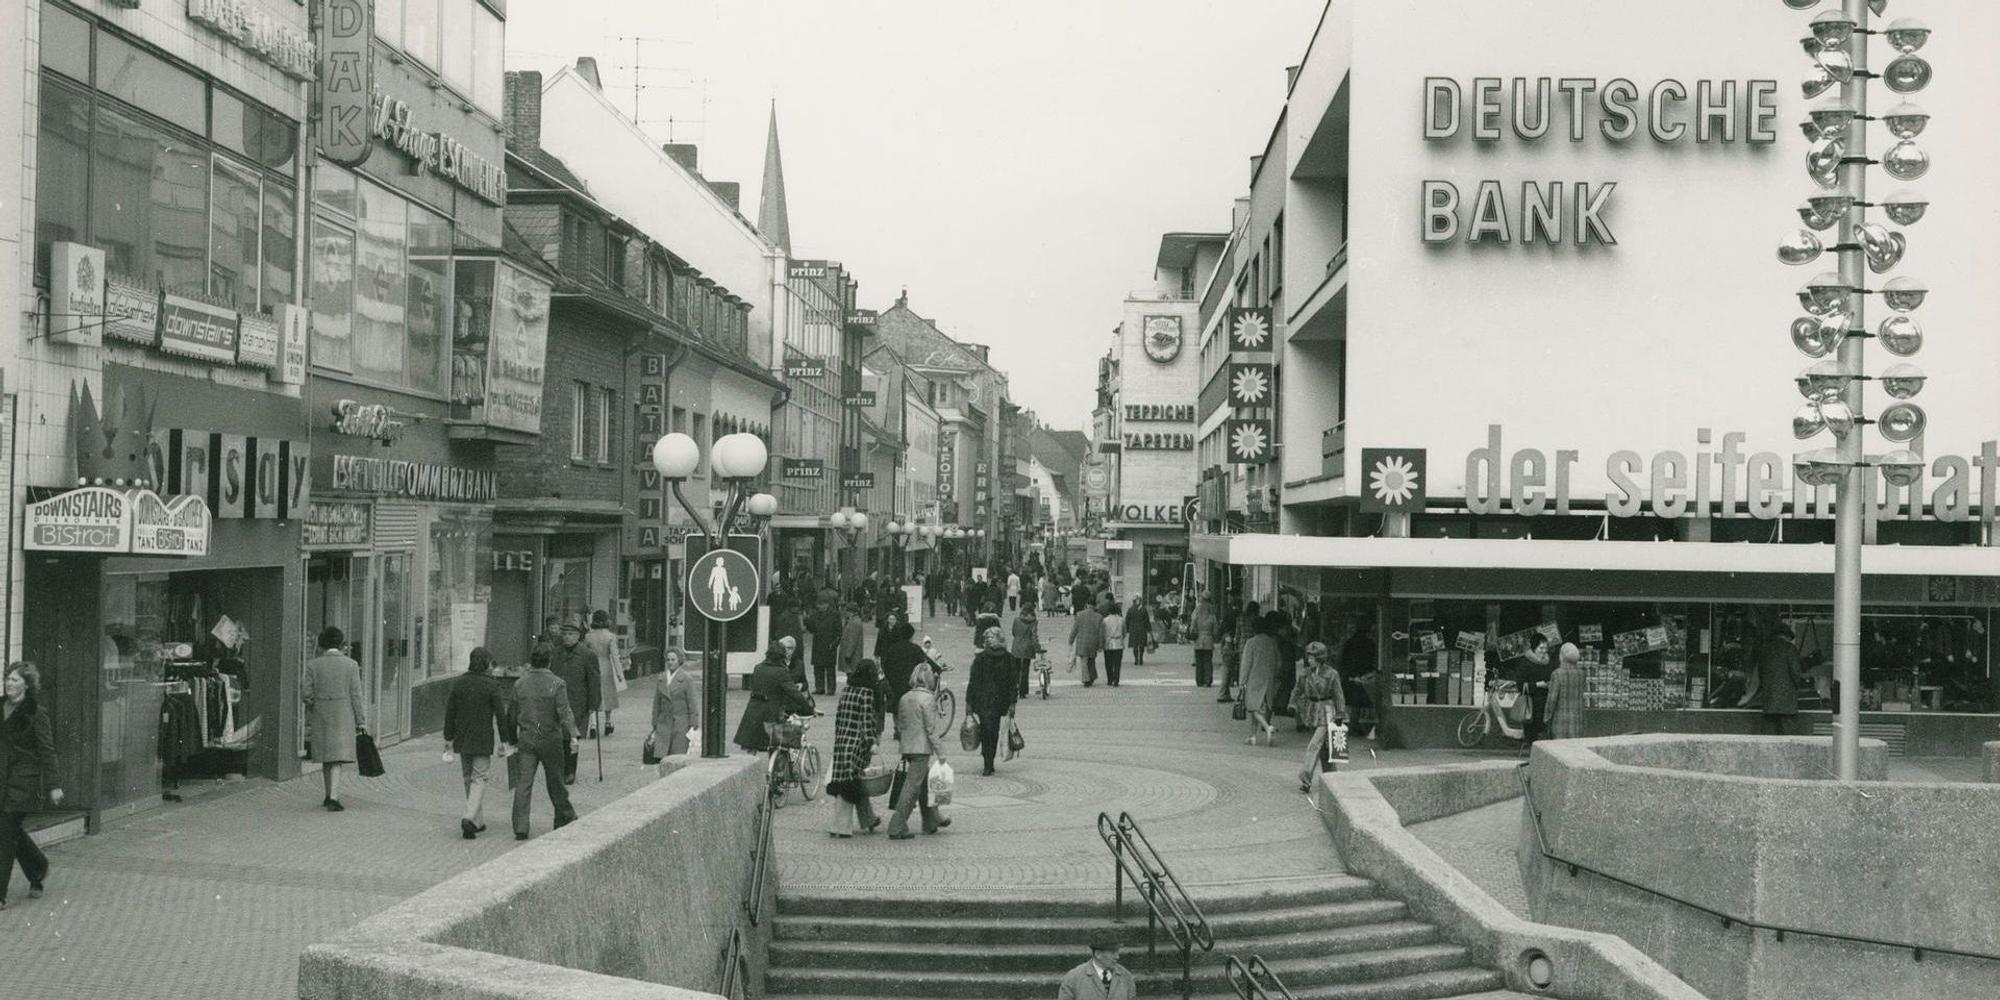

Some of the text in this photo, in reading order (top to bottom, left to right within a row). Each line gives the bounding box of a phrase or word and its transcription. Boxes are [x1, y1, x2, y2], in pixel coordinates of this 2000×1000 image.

[1423, 77, 1778, 143] DEUTSCHE
[1421, 180, 1618, 245] BANK
[791, 261, 824, 276] prinz
[165, 304, 235, 346] downstairs
[848, 310, 875, 324] prinz
[789, 360, 823, 376] prinz
[846, 392, 873, 406] prinz
[1124, 404, 1195, 421] TEPPICHE
[643, 357, 659, 545] BATAVIA
[1124, 433, 1194, 450] TAPETEN
[786, 463, 822, 477] prinz
[940, 453, 951, 494] FOTO
[1465, 424, 1578, 516] der
[843, 474, 872, 488] prinz
[976, 463, 988, 515] ERBA
[35, 491, 122, 519] DOWNSTAIRS
[41, 525, 115, 546] Bistrot
[138, 537, 155, 549] TANZ
[186, 539, 203, 552] TANZ
